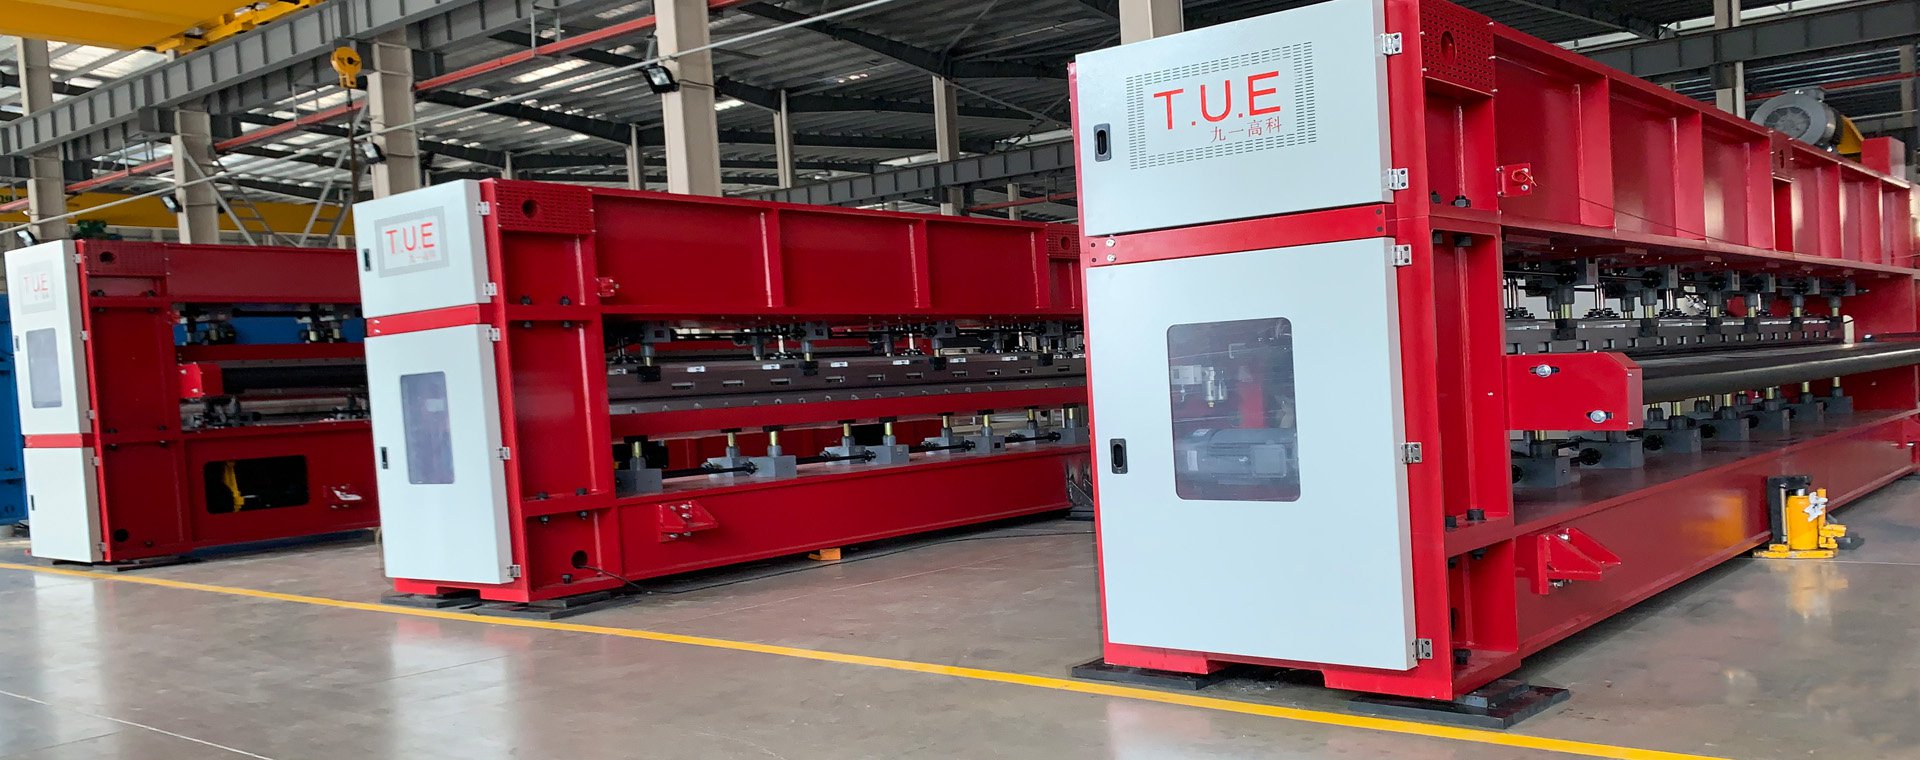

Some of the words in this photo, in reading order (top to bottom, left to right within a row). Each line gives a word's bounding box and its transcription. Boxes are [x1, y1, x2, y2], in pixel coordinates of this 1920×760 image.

[1153, 71, 1281, 130] T.U.E
[1210, 116, 1282, 143] 九一高科
